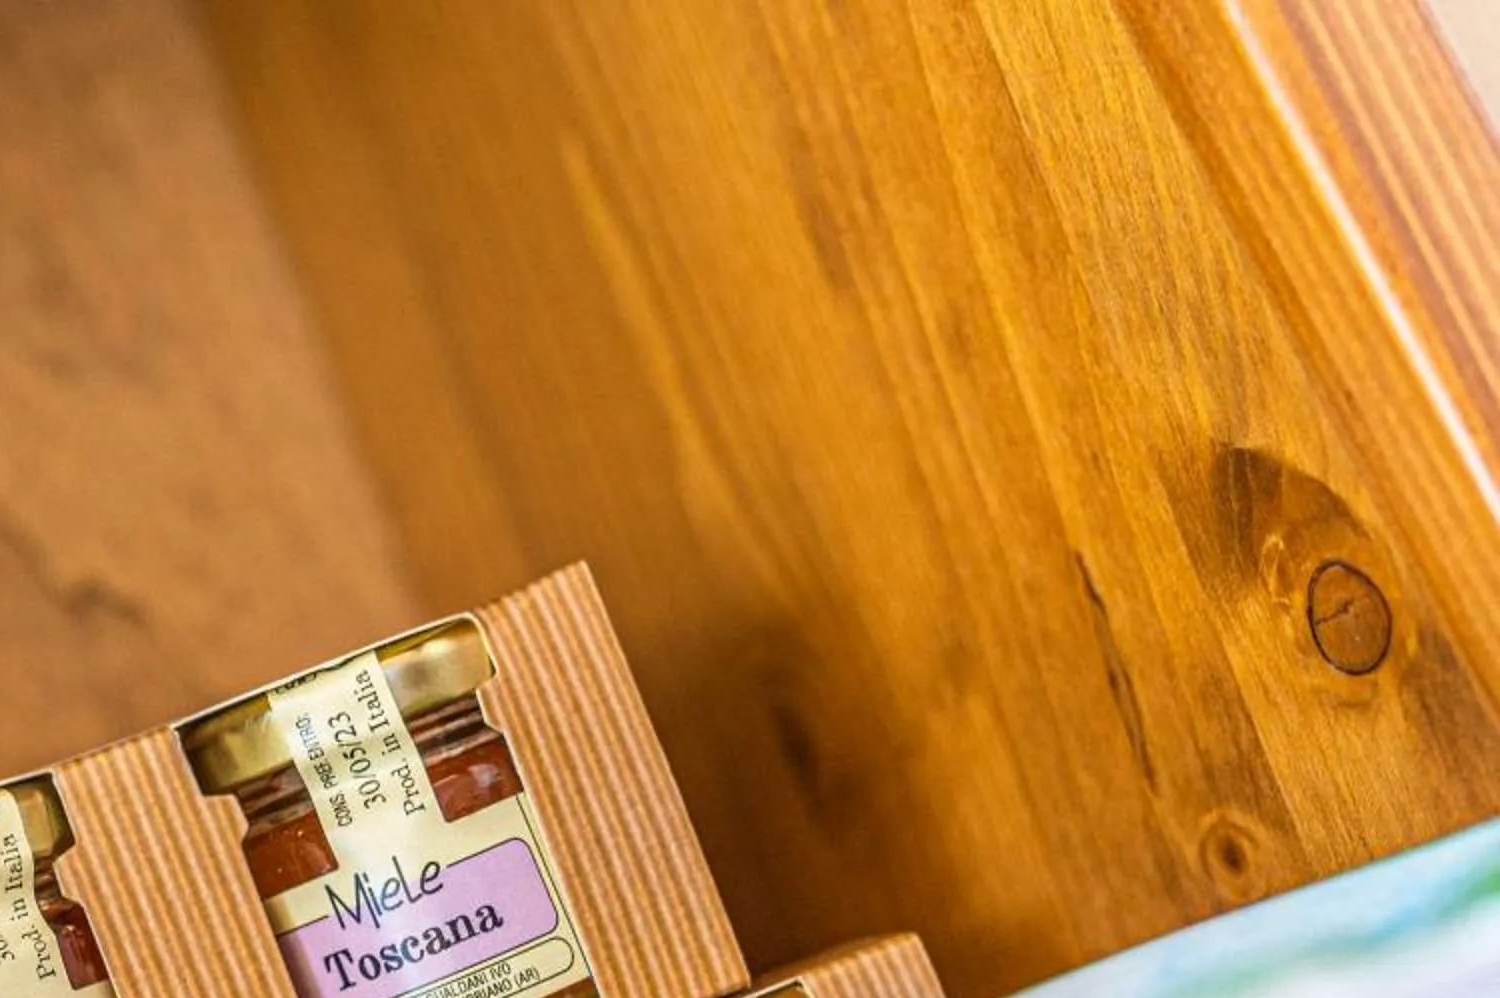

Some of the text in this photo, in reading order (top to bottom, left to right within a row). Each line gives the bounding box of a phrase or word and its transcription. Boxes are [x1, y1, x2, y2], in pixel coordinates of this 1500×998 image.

[327, 711, 387, 809] 30/05/23
[354, 669, 426, 816] Prod. in Italia
[0, 833, 57, 981] Prod. in Italia
[323, 904, 504, 992] Toscana
[490, 963, 512, 983] IVO
[515, 966, 541, 991] (AR)
